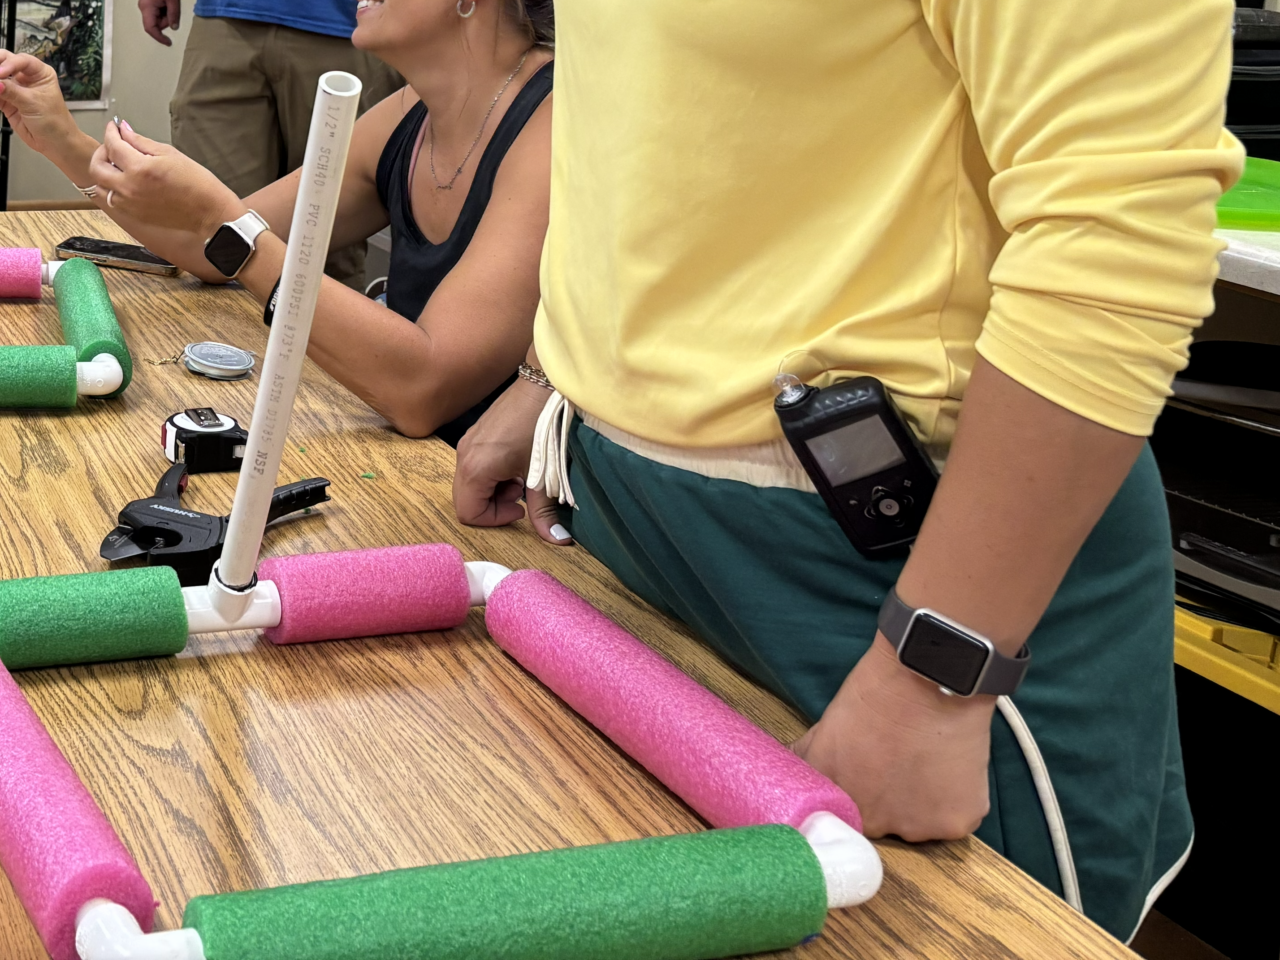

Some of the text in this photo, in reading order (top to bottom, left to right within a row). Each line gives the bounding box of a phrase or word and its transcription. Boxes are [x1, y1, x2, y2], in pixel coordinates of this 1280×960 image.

[306, 203, 320, 228] PVC
[299, 234, 315, 266] 1120
[288, 273, 307, 318] 600PSI
[269, 373, 285, 405] ASTM
[253, 450, 268, 476] NSF
